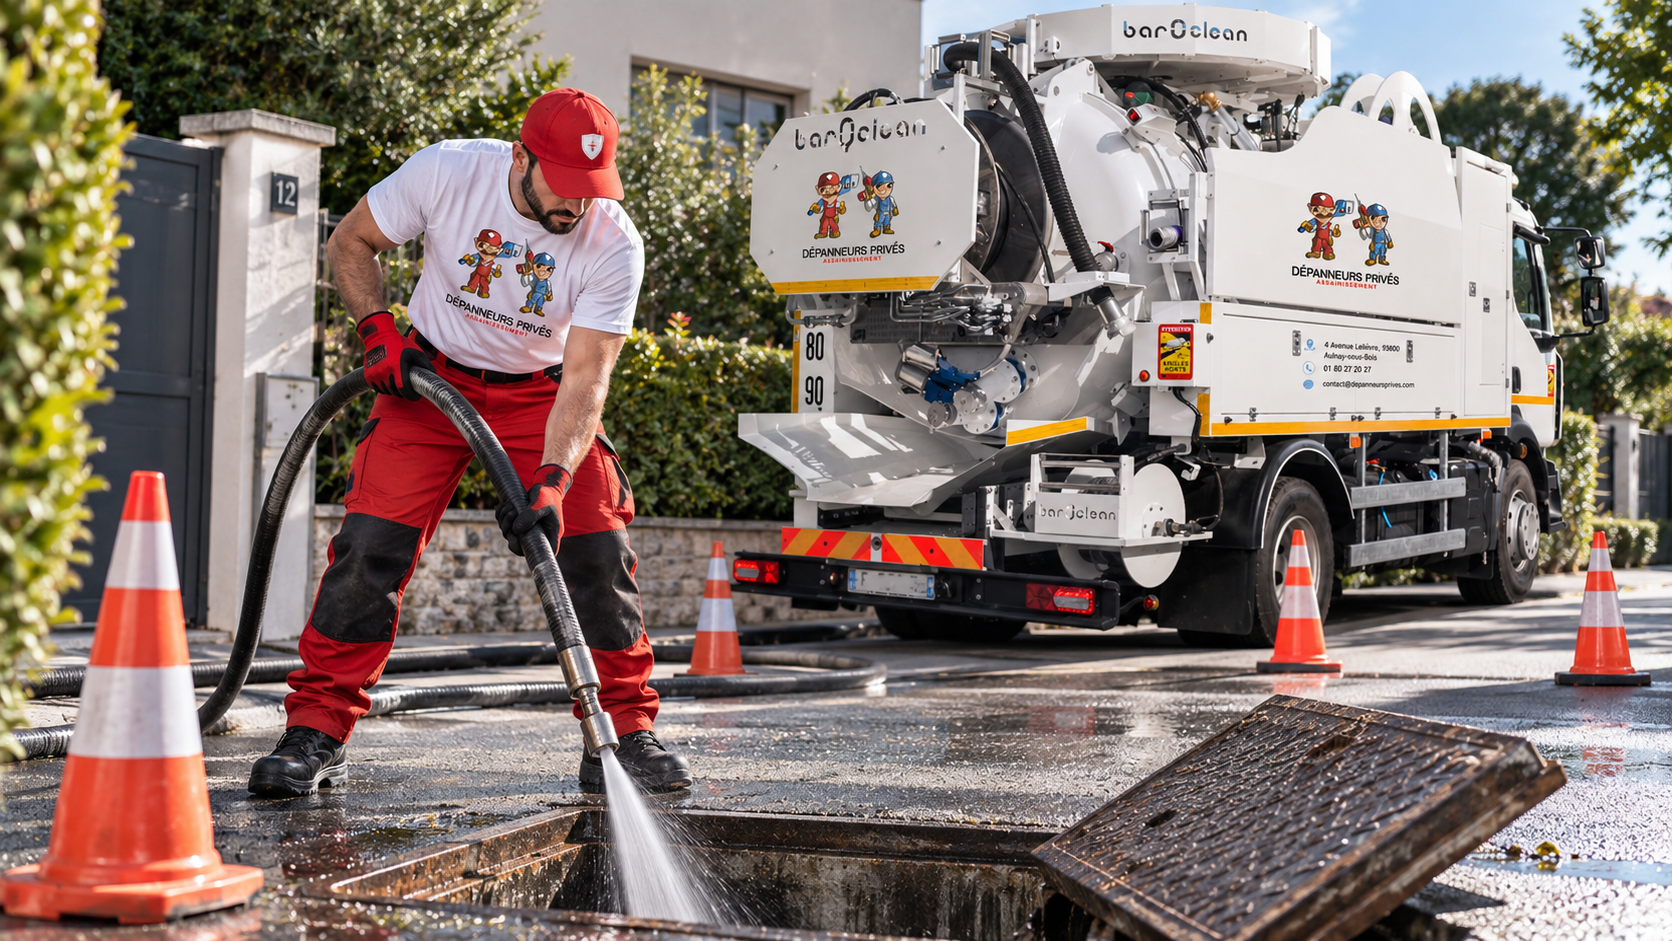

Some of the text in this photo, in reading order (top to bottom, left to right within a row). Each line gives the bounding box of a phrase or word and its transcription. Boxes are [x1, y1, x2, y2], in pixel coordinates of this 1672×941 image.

[276, 179, 296, 207] 12
[802, 240, 906, 259] DÉPANNEURS PRIVÉS
[1291, 264, 1400, 286] DÉPANNEURS PRIVÉS
[445, 293, 553, 338] DÉPANNEURS PRIVÉS
[806, 331, 824, 361] 80
[1330, 342, 1354, 350] Avenue
[805, 376, 824, 406] 90
[1322, 380, 1415, 389] contact@depanneursprives.com
